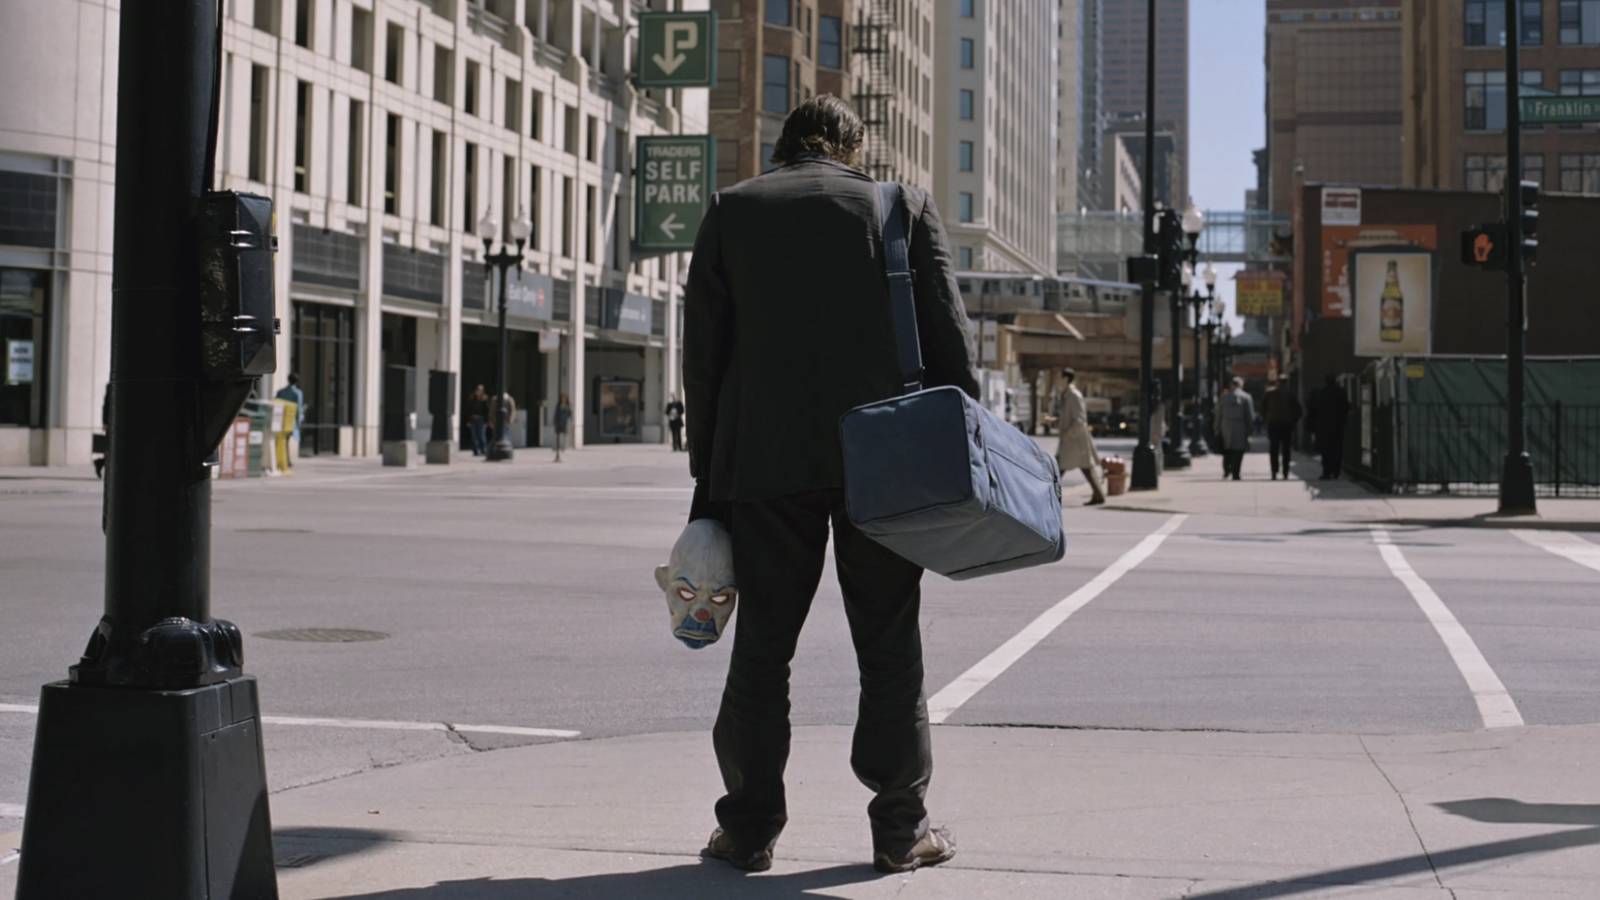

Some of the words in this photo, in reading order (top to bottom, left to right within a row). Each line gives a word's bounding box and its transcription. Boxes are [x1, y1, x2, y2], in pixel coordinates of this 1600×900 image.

[1535, 101, 1592, 117] Franklin
[647, 145, 701, 157] TRADERS
[645, 160, 701, 181] SELF
[645, 184, 701, 204] PARK
